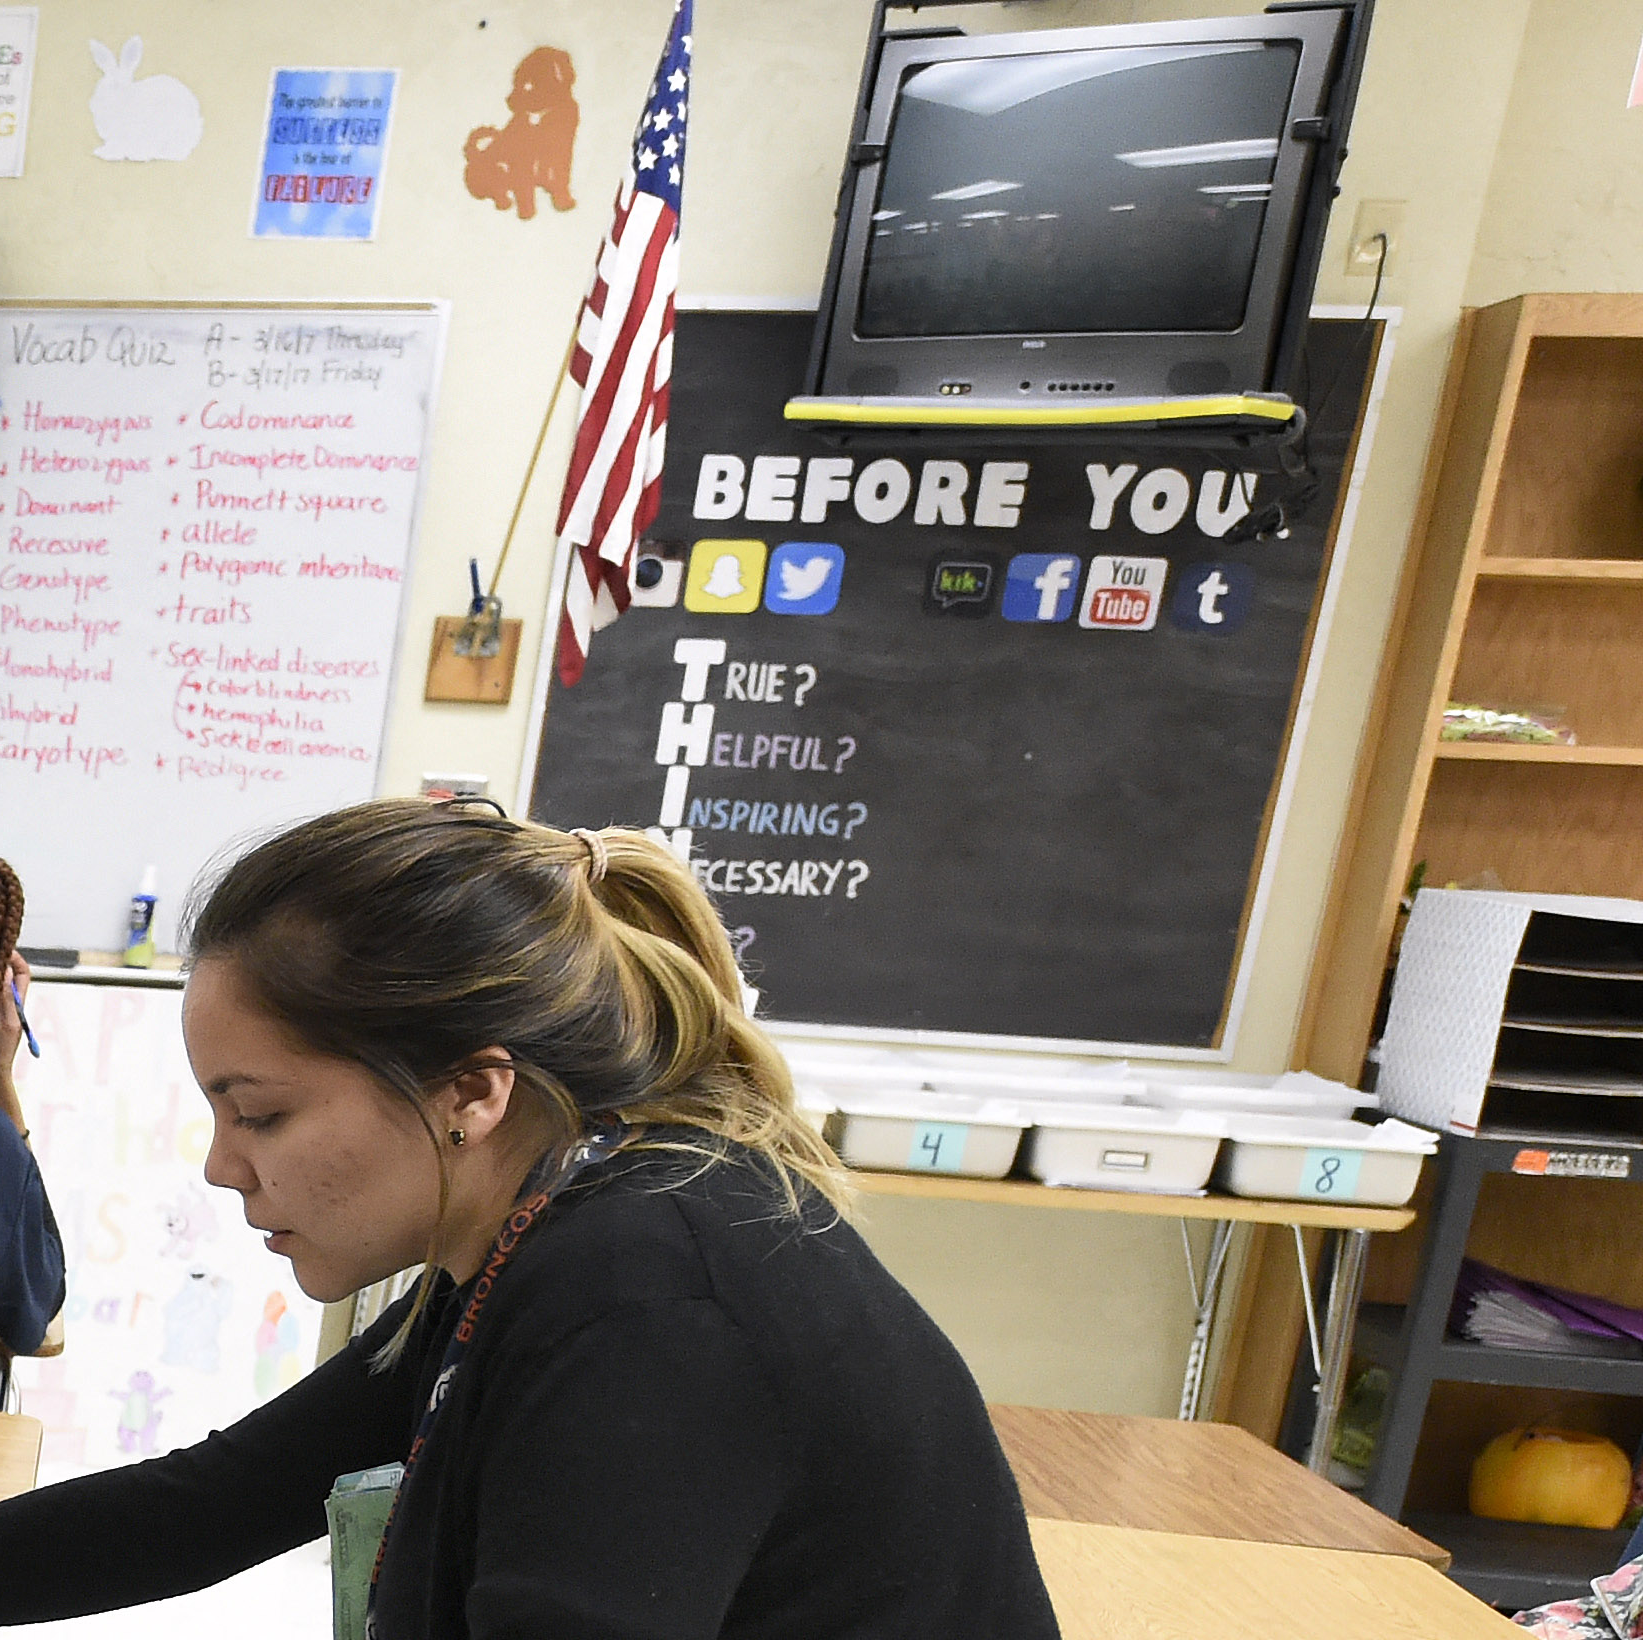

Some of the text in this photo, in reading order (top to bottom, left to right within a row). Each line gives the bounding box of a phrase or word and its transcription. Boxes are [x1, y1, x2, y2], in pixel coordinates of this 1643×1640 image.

[12, 322, 99, 366] Vocab
[105, 324, 177, 368] Quiz
[322, 359, 384, 391] Friday
[199, 398, 356, 431] Codominance
[294, 493, 389, 522] square
[692, 453, 1258, 538] BEFORE YOU
[1033, 557, 1076, 621] f
[1110, 561, 1148, 589] You
[175, 593, 253, 625] traits
[1092, 589, 1149, 624] Tube
[1197, 571, 1230, 624] t
[0, 603, 123, 652] Phenotype
[165, 640, 381, 679] Sex-linked diseases
[921, 1132, 942, 1166] 4
[1313, 1154, 1339, 1193] 8
